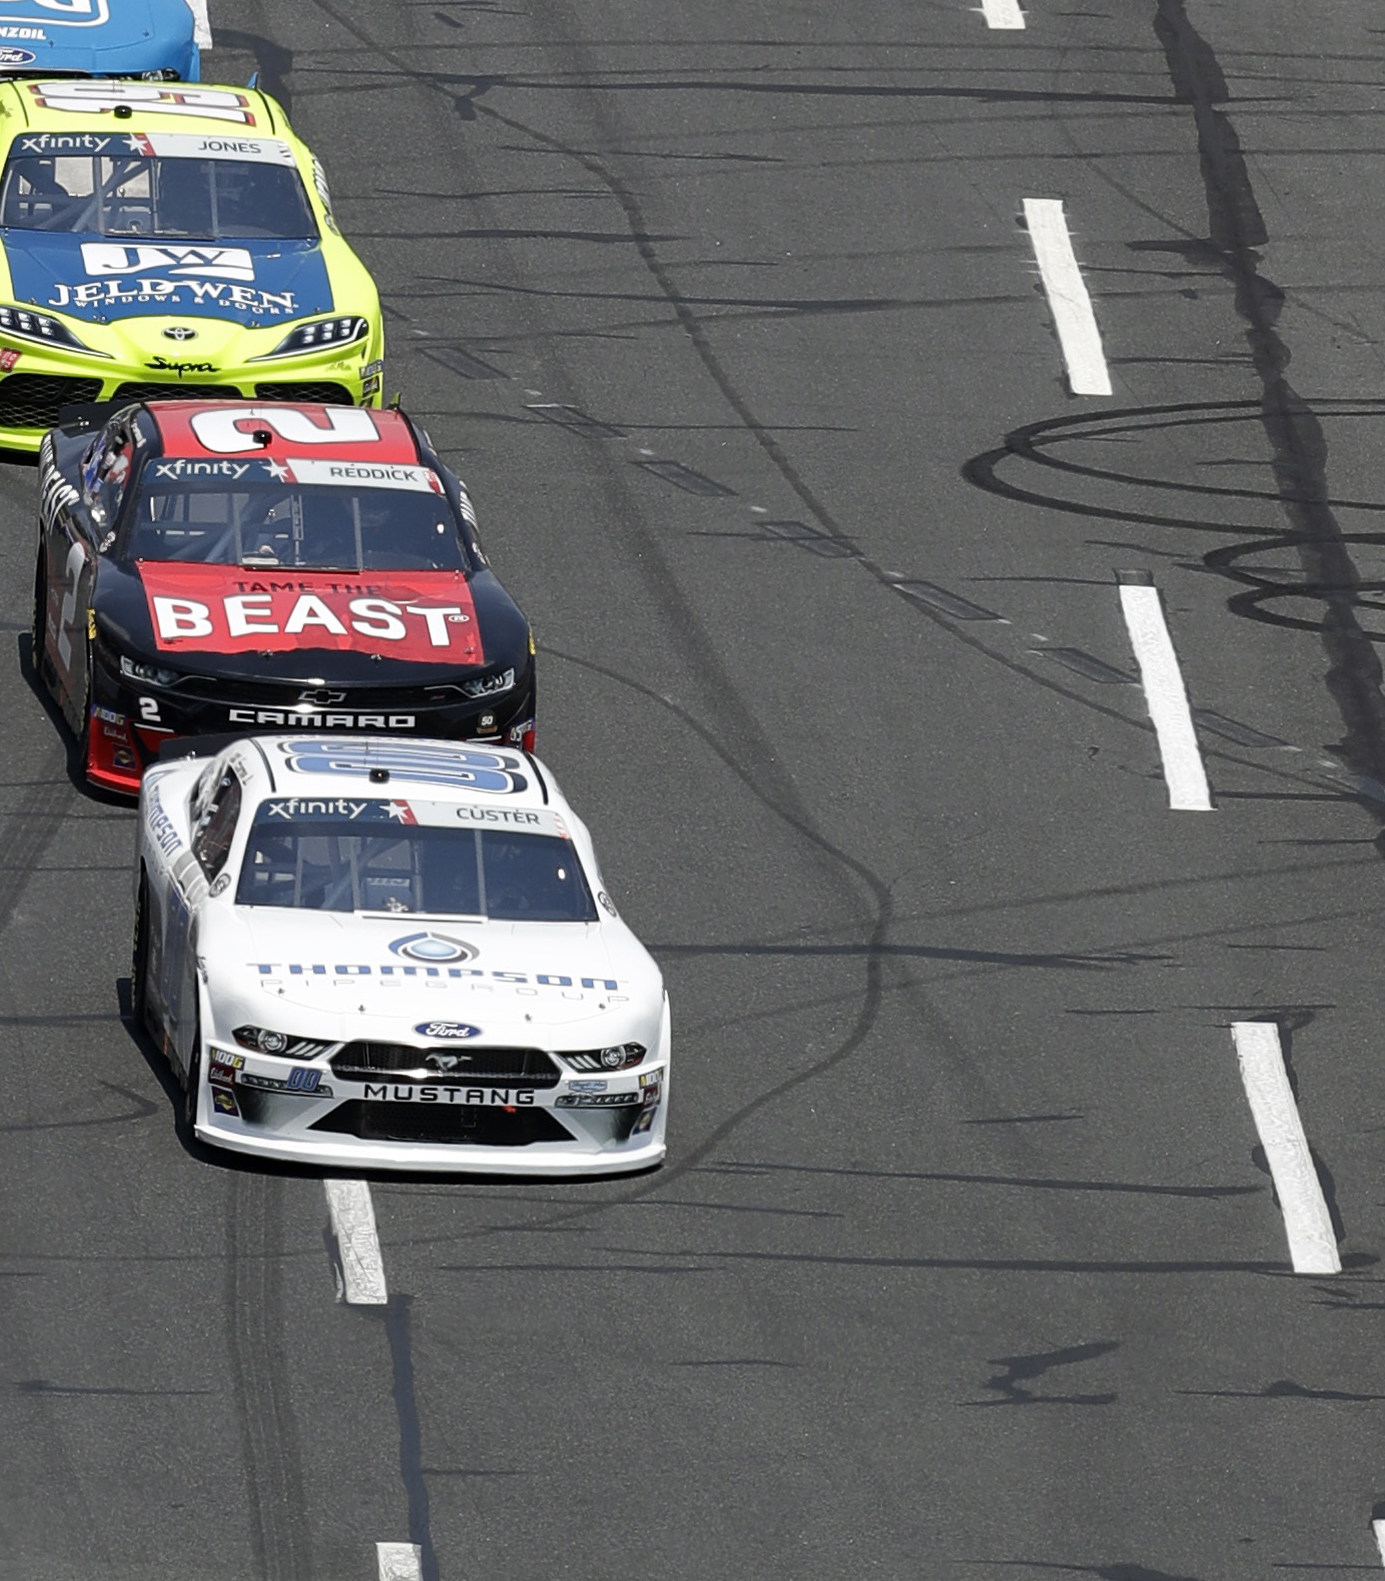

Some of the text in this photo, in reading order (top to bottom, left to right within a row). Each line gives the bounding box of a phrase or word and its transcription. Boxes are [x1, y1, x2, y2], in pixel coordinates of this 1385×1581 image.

[21, 134, 113, 153] xfinity
[197, 140, 262, 154] JONES
[48, 279, 296, 310] JELD-WEN
[144, 357, 221, 379] Supra
[155, 458, 251, 480] xfinity
[329, 466, 419, 482] REDDICK
[233, 581, 381, 596] TAME THE
[152, 594, 462, 647] BEAST
[138, 697, 162, 722] 2
[228, 709, 416, 728] CAMARO
[267, 798, 369, 819] xfinity
[455, 806, 542, 826] CUSTER
[245, 962, 630, 992] THOMPSON
[424, 1022, 471, 1039] Ford
[287, 1066, 322, 1092] 00
[363, 1083, 535, 1105] MUSTANG
